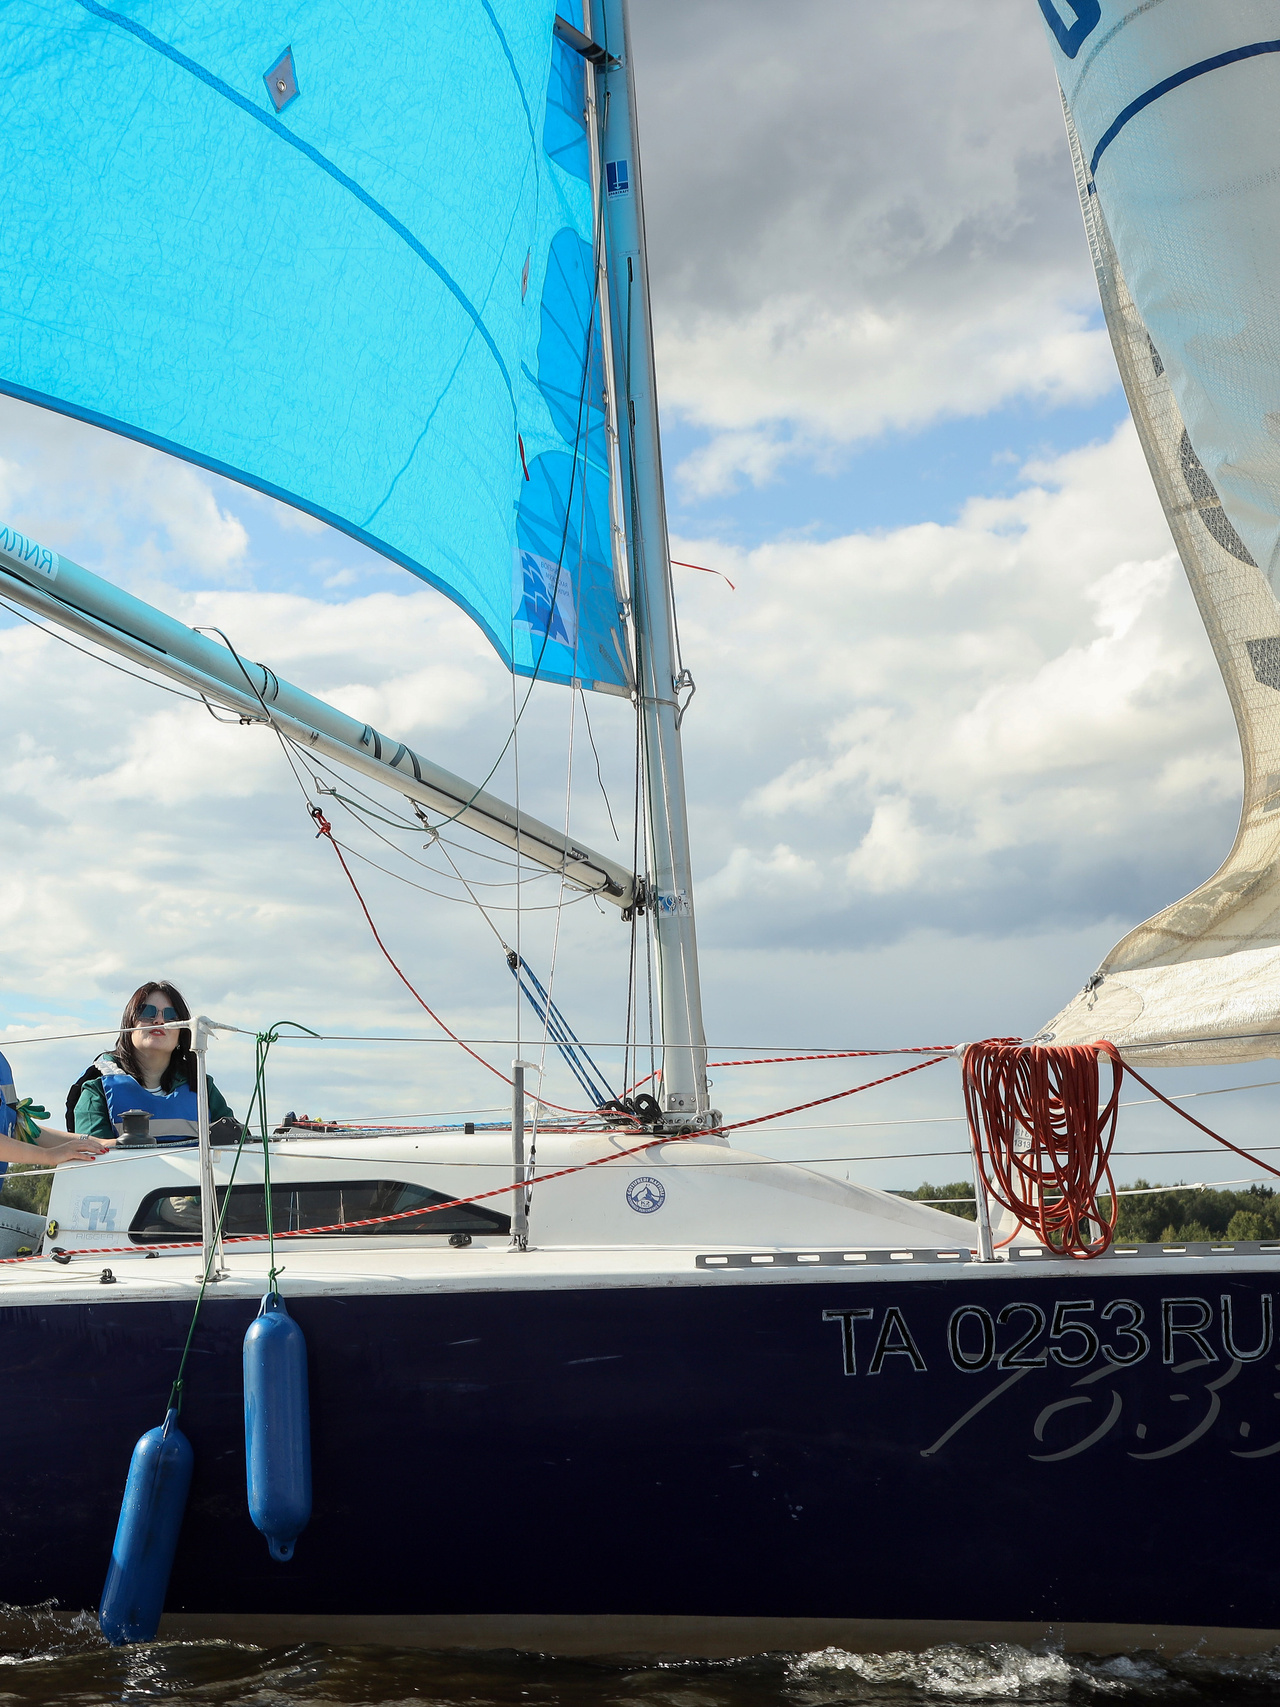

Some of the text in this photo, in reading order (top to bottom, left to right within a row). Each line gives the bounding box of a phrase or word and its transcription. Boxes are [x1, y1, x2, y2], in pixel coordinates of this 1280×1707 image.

[822, 1293, 1280, 1376] TA 0253 RU
